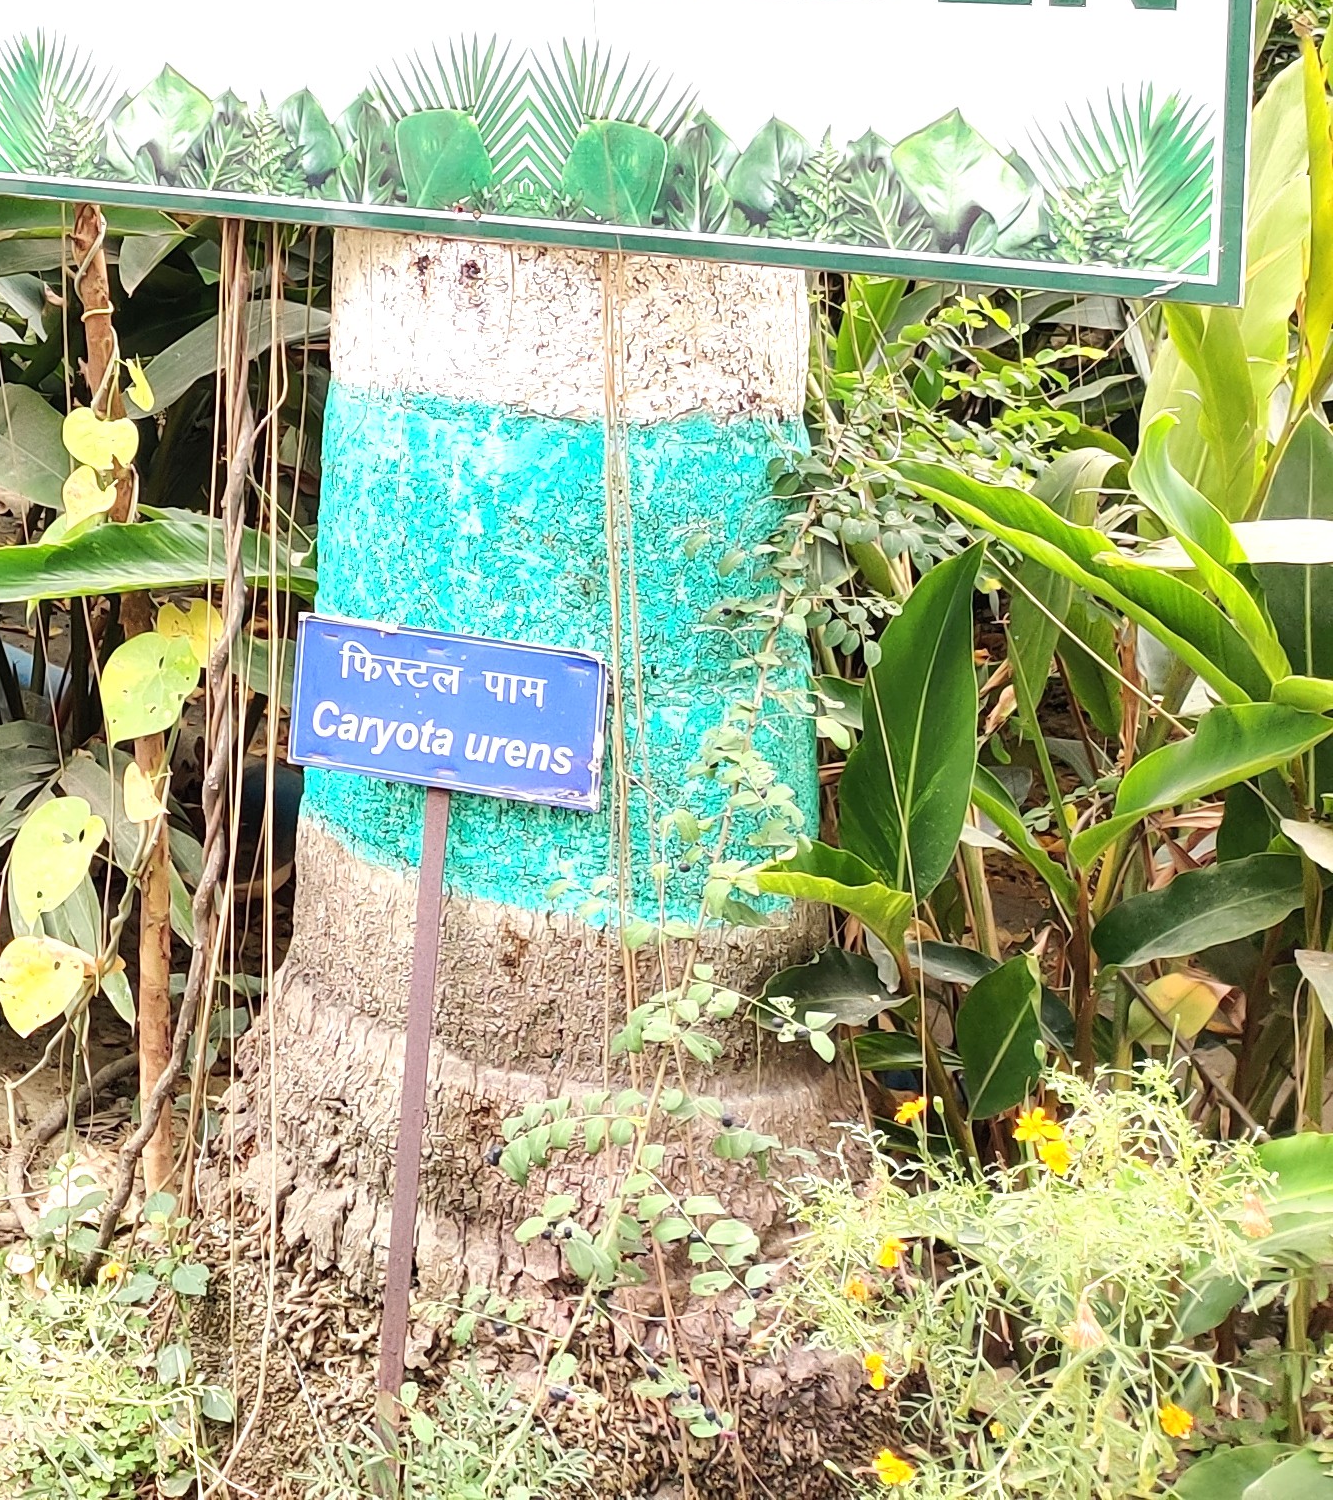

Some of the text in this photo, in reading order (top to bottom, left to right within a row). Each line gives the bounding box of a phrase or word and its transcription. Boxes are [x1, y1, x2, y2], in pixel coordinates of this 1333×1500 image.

[482, 670, 547, 707] पाम
[312, 700, 574, 775] Caryota urens
